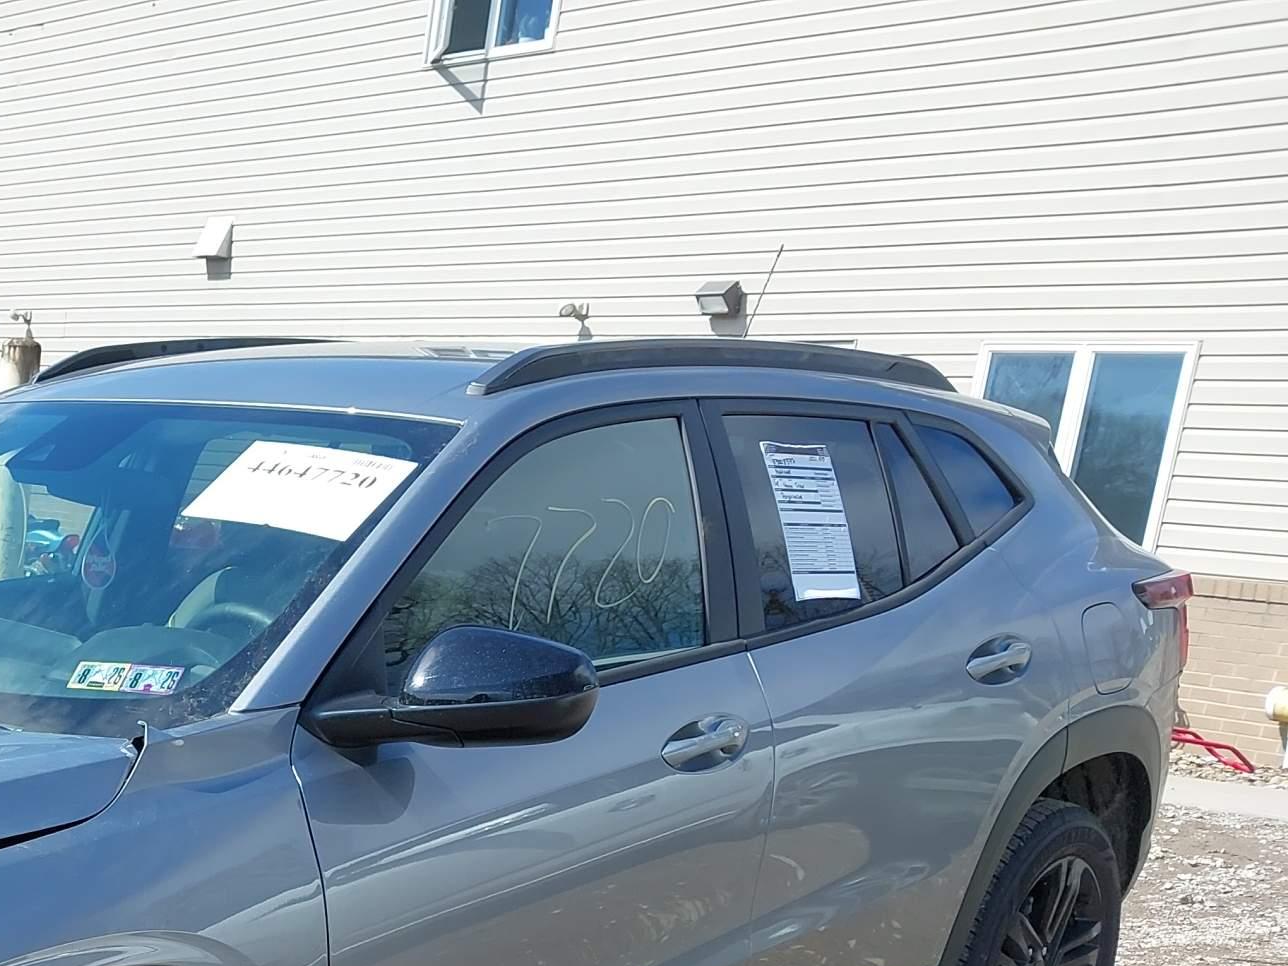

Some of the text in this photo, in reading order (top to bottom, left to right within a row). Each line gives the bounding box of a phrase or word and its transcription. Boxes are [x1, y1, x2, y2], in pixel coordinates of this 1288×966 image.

[247, 460, 377, 489] 44647720
[485, 497, 676, 631] 7720
[160, 670, 180, 690] 26
